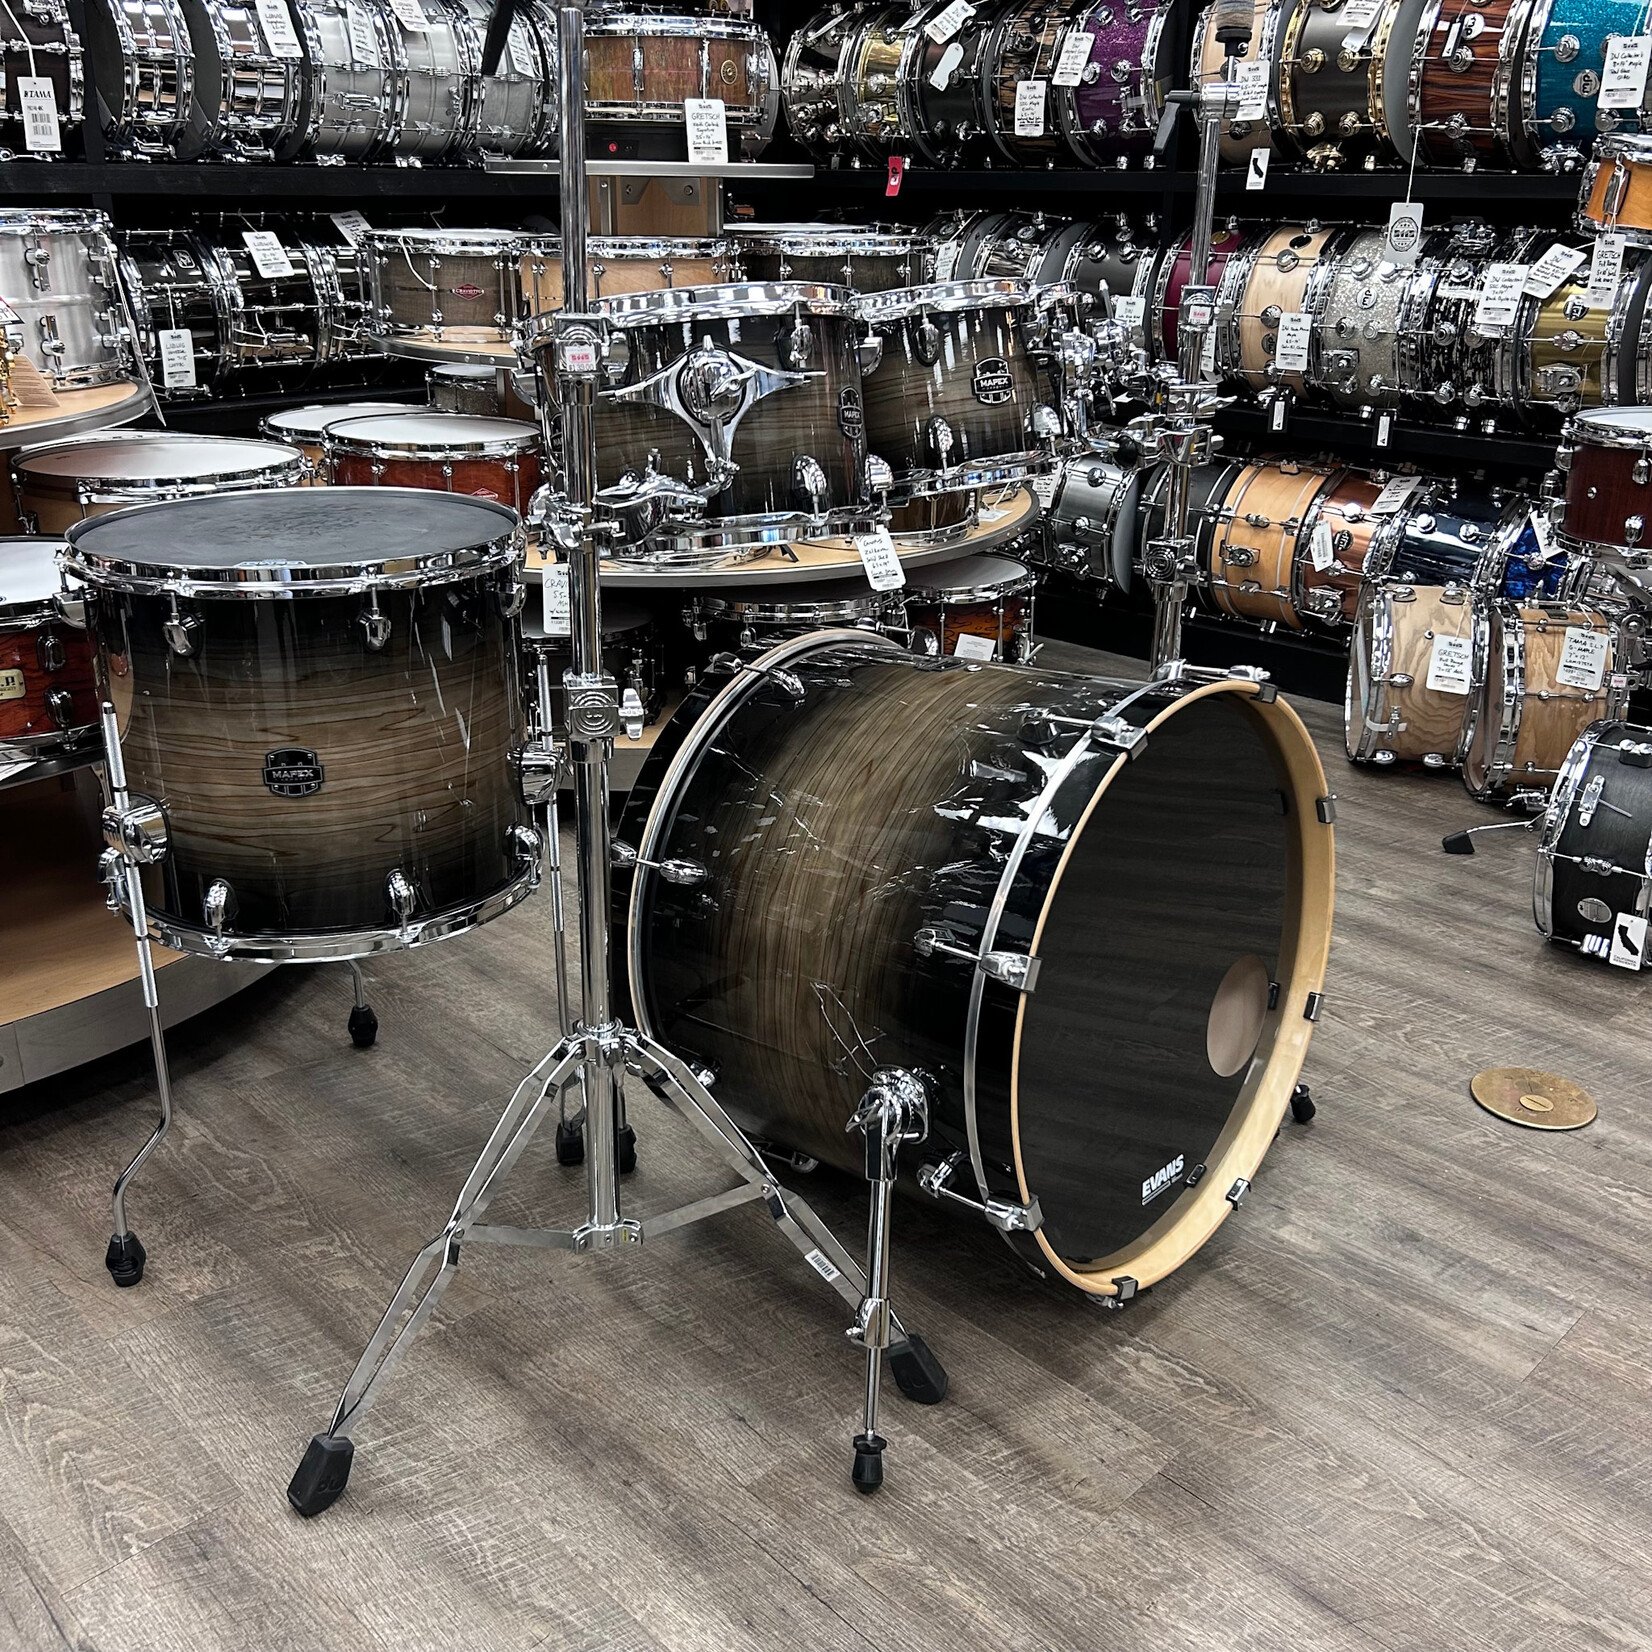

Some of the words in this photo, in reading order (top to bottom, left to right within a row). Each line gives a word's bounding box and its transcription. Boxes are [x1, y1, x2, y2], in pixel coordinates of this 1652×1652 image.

[1610, 52, 1620, 60] DW
[691, 112, 721, 121] GRETSCH
[1596, 249, 1621, 260] GRETSCH
[980, 377, 1009, 388] MAPEX
[844, 409, 861, 419] MAPEX
[1567, 636, 1587, 646] TAMA
[1437, 648, 1470, 660] GRETSCH
[272, 769, 314, 779] MAPEX
[1613, 954, 1637, 964] CALIFORNIA
[1141, 1153, 1185, 1199] EVANS
